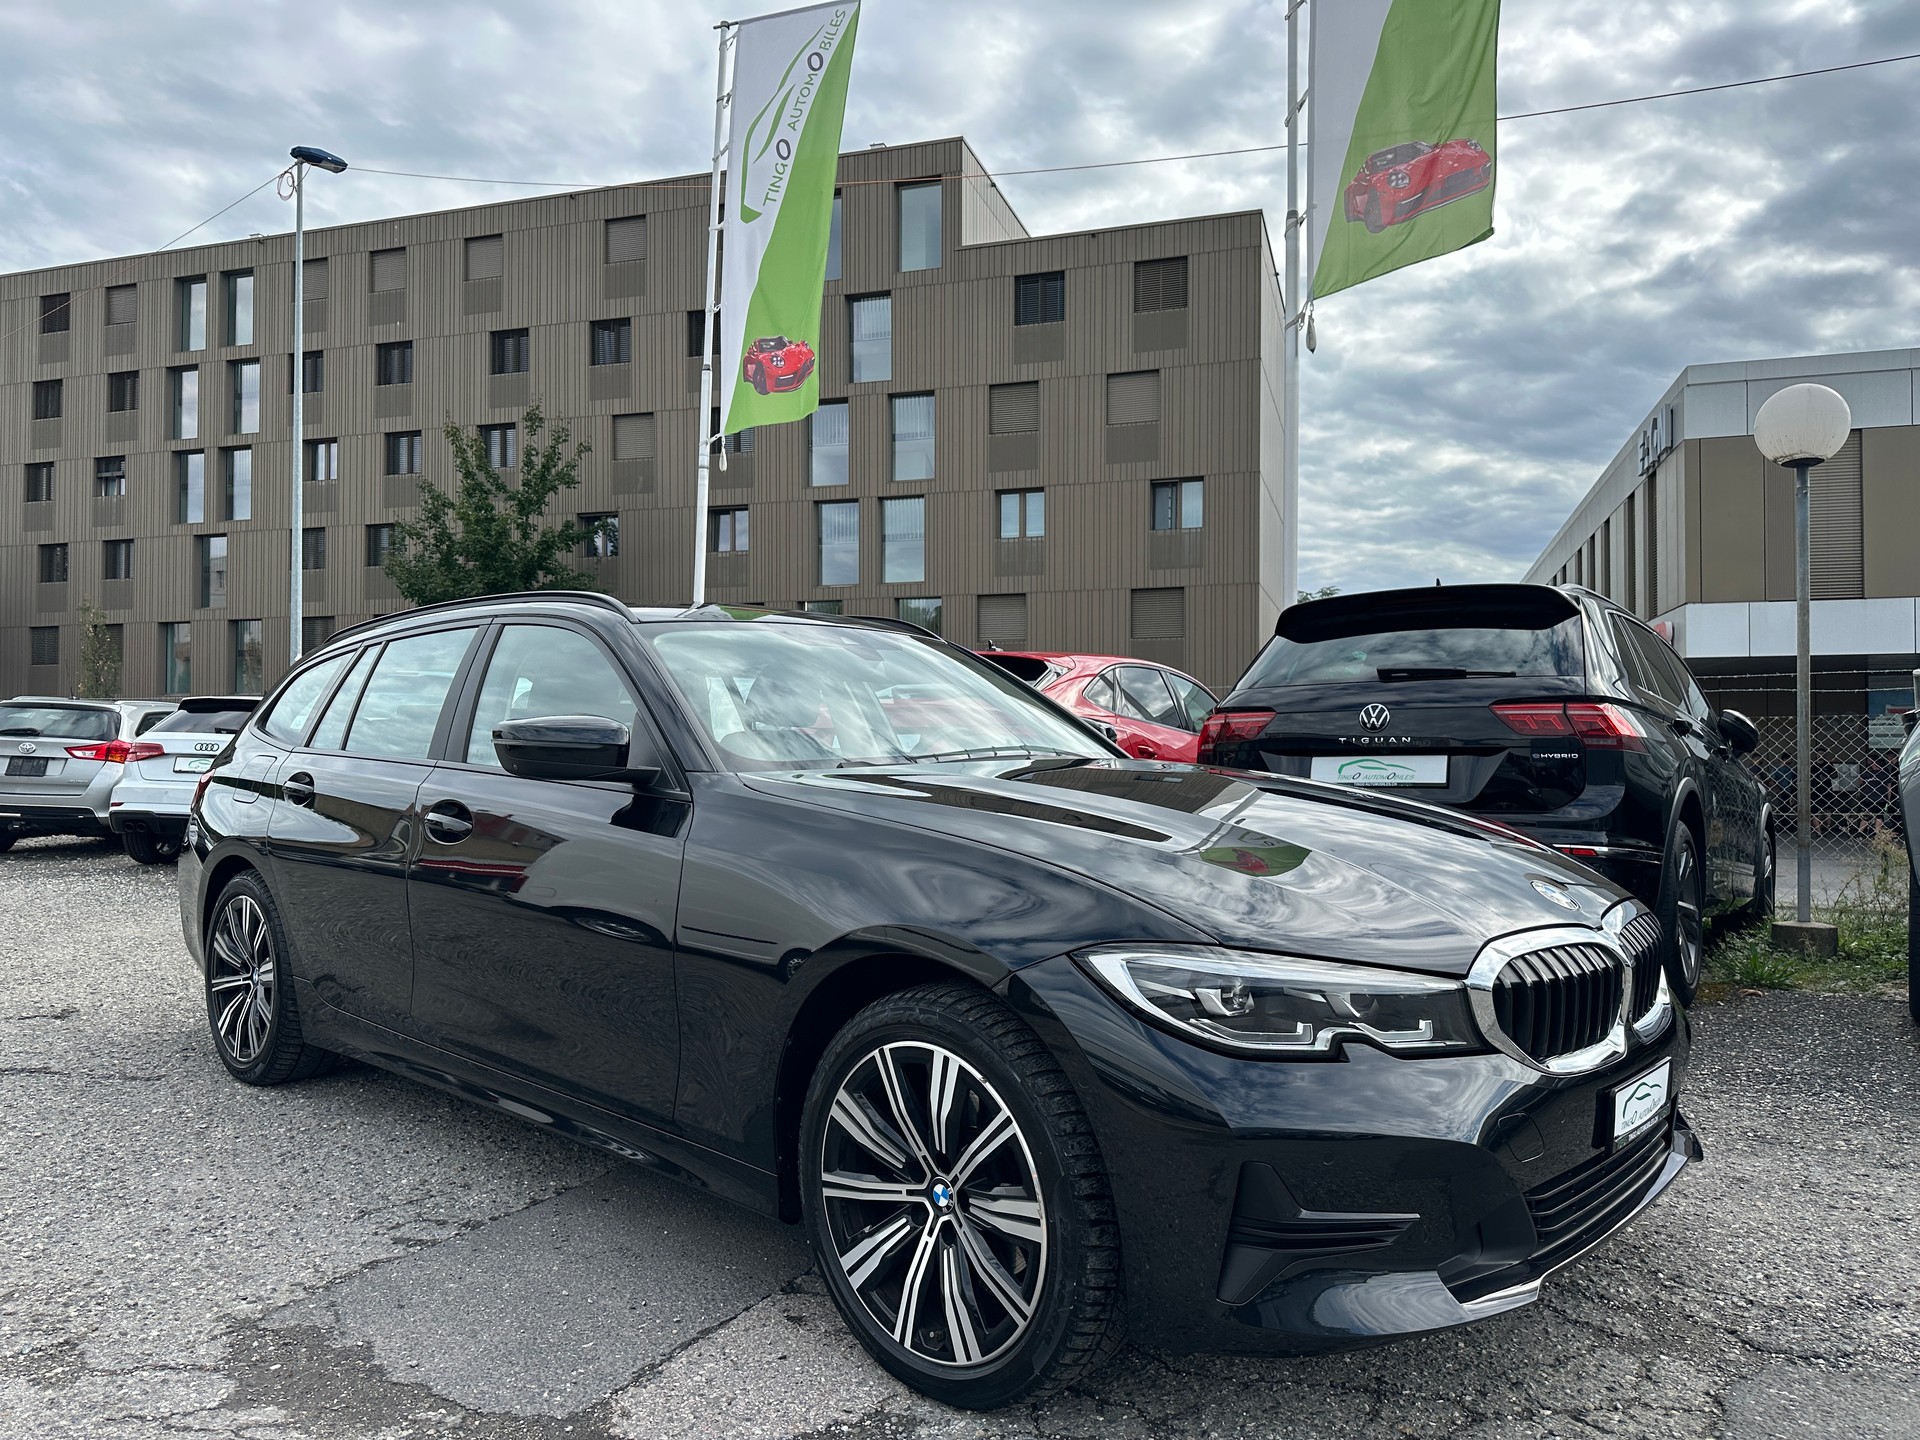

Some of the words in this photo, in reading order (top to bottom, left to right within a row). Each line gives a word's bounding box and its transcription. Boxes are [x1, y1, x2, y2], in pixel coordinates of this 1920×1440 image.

[763, 138, 791, 207] TINGO
[787, 9, 846, 131] AUTOMOBILES
[1338, 736, 1411, 744] TIGUAN
